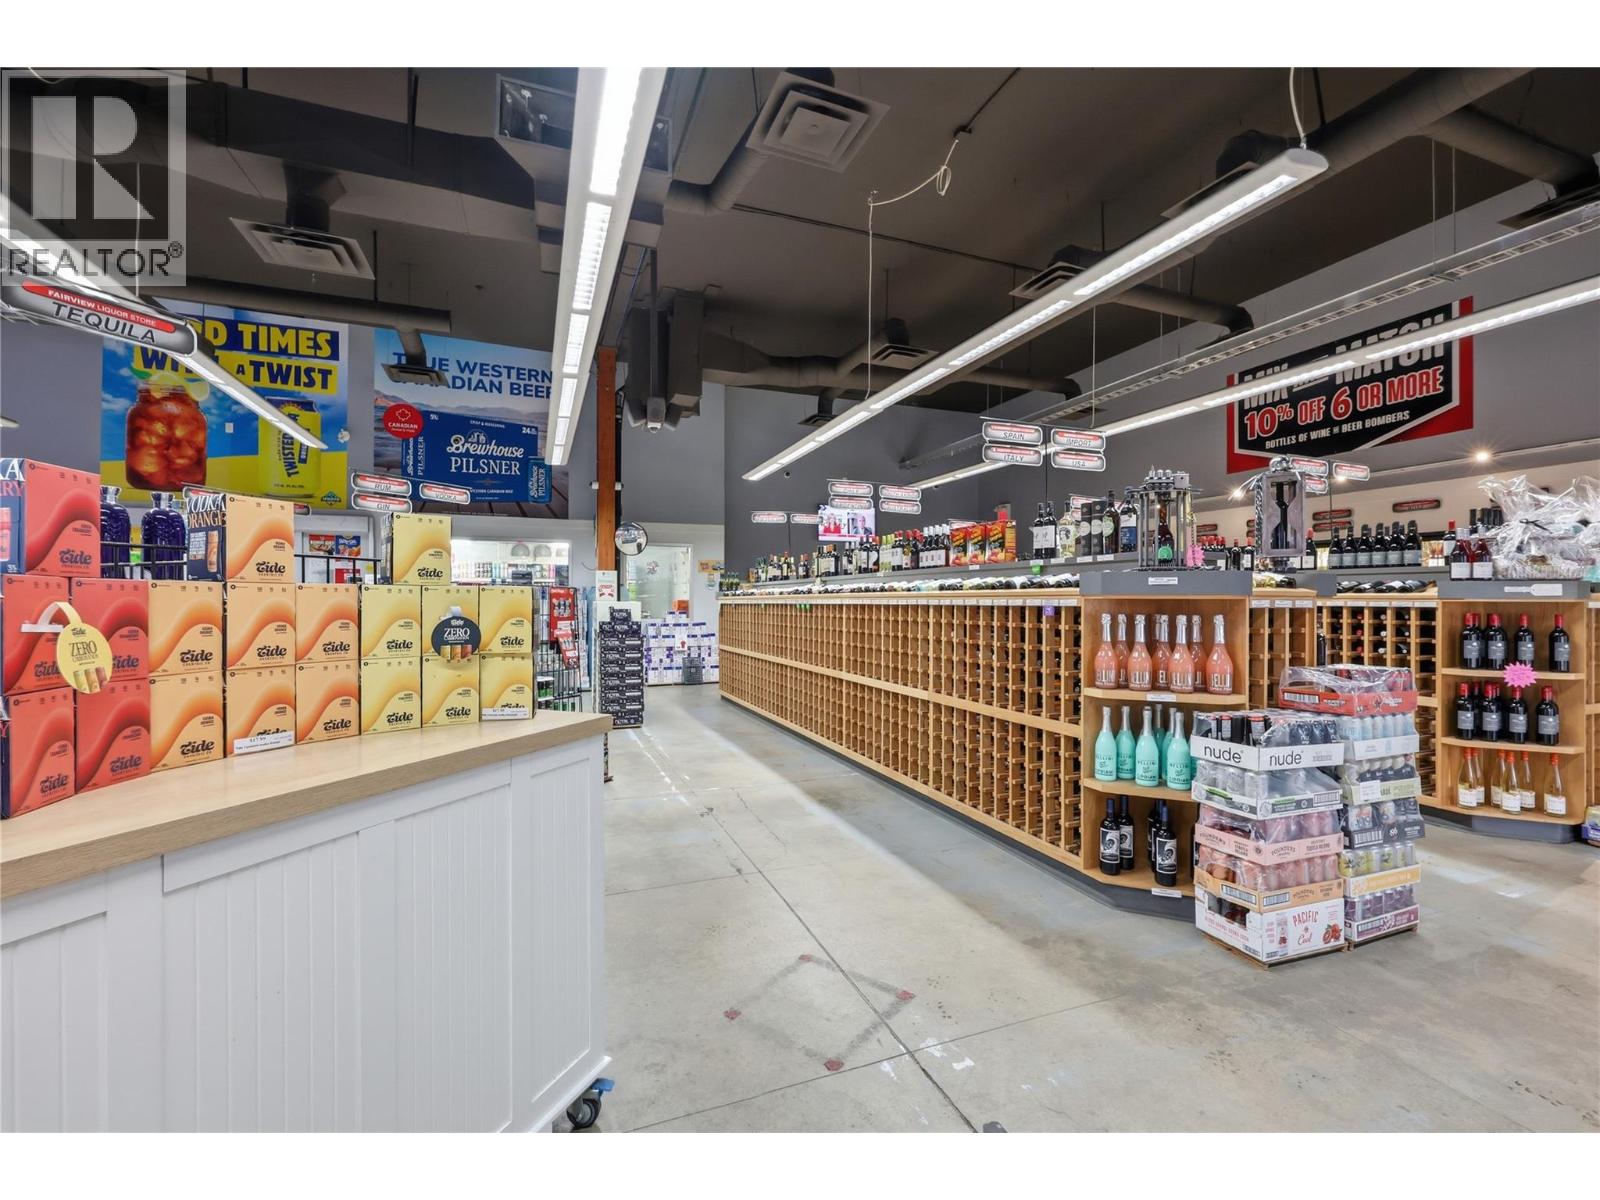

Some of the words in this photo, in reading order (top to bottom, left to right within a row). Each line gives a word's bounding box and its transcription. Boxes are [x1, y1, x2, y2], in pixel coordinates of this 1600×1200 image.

[48, 289, 95, 309] FAIRVIEW
[97, 304, 128, 319] LIQUOR
[130, 314, 157, 327] STORE
[52, 301, 156, 343] TEQUILA
[237, 323, 332, 358] TIMES
[236, 364, 246, 376] A
[249, 359, 333, 390] TWIST
[1244, 403, 1294, 440] 10%
[1297, 396, 1326, 425] OFF
[1331, 386, 1352, 420] 6
[1356, 381, 1383, 410] OR
[1386, 365, 1444, 405] MORE
[1003, 431, 1025, 440] SPAIN
[1265, 435, 1296, 449] BOTTLES
[1298, 431, 1308, 442] OF
[1310, 427, 1331, 440] WINE
[1341, 420, 1363, 433] BEER
[1365, 410, 1410, 427] BOMBERS
[447, 435, 524, 458] Brewhouse
[1065, 438, 1092, 447] IMPORT
[450, 457, 521, 476] PILSNER
[1003, 454, 1024, 463] ITALY
[375, 484, 391, 492] RUM
[538, 468, 546, 497] PILSNER
[186, 493, 226, 512] VODKA
[377, 503, 390, 511] GIN
[187, 510, 226, 528] ORANGE
[59, 548, 92, 565] Tide
[256, 561, 286, 574] Tide
[417, 567, 444, 578] Tide
[444, 628, 470, 637] ZERO
[68, 640, 98, 657] ZERO
[322, 641, 350, 652] Tide
[386, 639, 413, 650] Tide
[500, 636, 525, 646] Tide
[180, 649, 213, 663] Tide
[256, 645, 287, 657] Tide
[34, 660, 60, 677] Tid
[386, 712, 413, 723] Tide
[446, 707, 471, 717] Tide
[323, 718, 352, 731] Tide
[180, 740, 215, 755] Tide
[1204, 746, 1242, 763] nude
[110, 755, 142, 773] Tide
[1269, 751, 1302, 766] nude
[40, 773, 69, 793] Tide
[1292, 910, 1319, 927] PACIFIC
